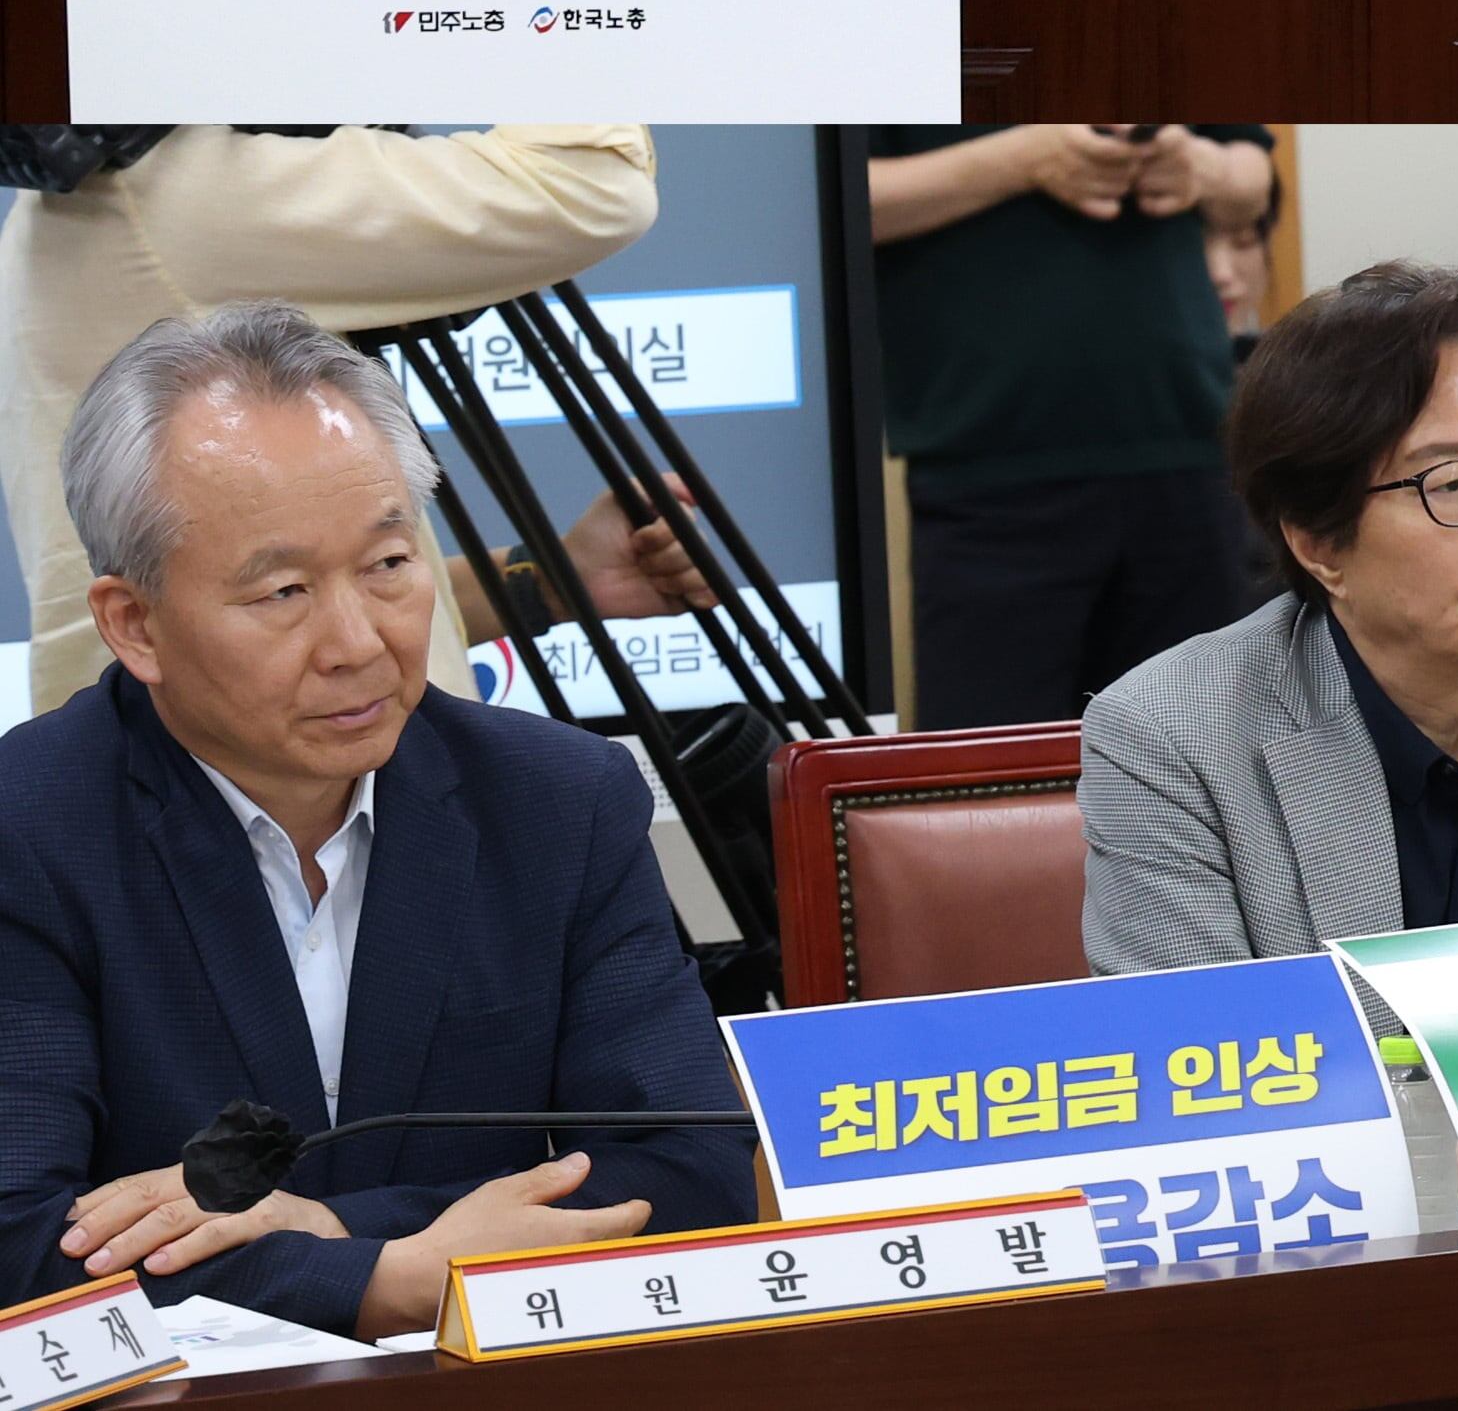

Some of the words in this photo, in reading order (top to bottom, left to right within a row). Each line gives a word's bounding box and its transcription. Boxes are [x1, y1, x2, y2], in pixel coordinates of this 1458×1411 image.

[418, 9, 506, 33] 민주노총
[562, 7, 647, 32] 한국노총
[818, 1067, 1140, 1158] 최저임금
[1168, 1032, 1324, 1117] 인상
